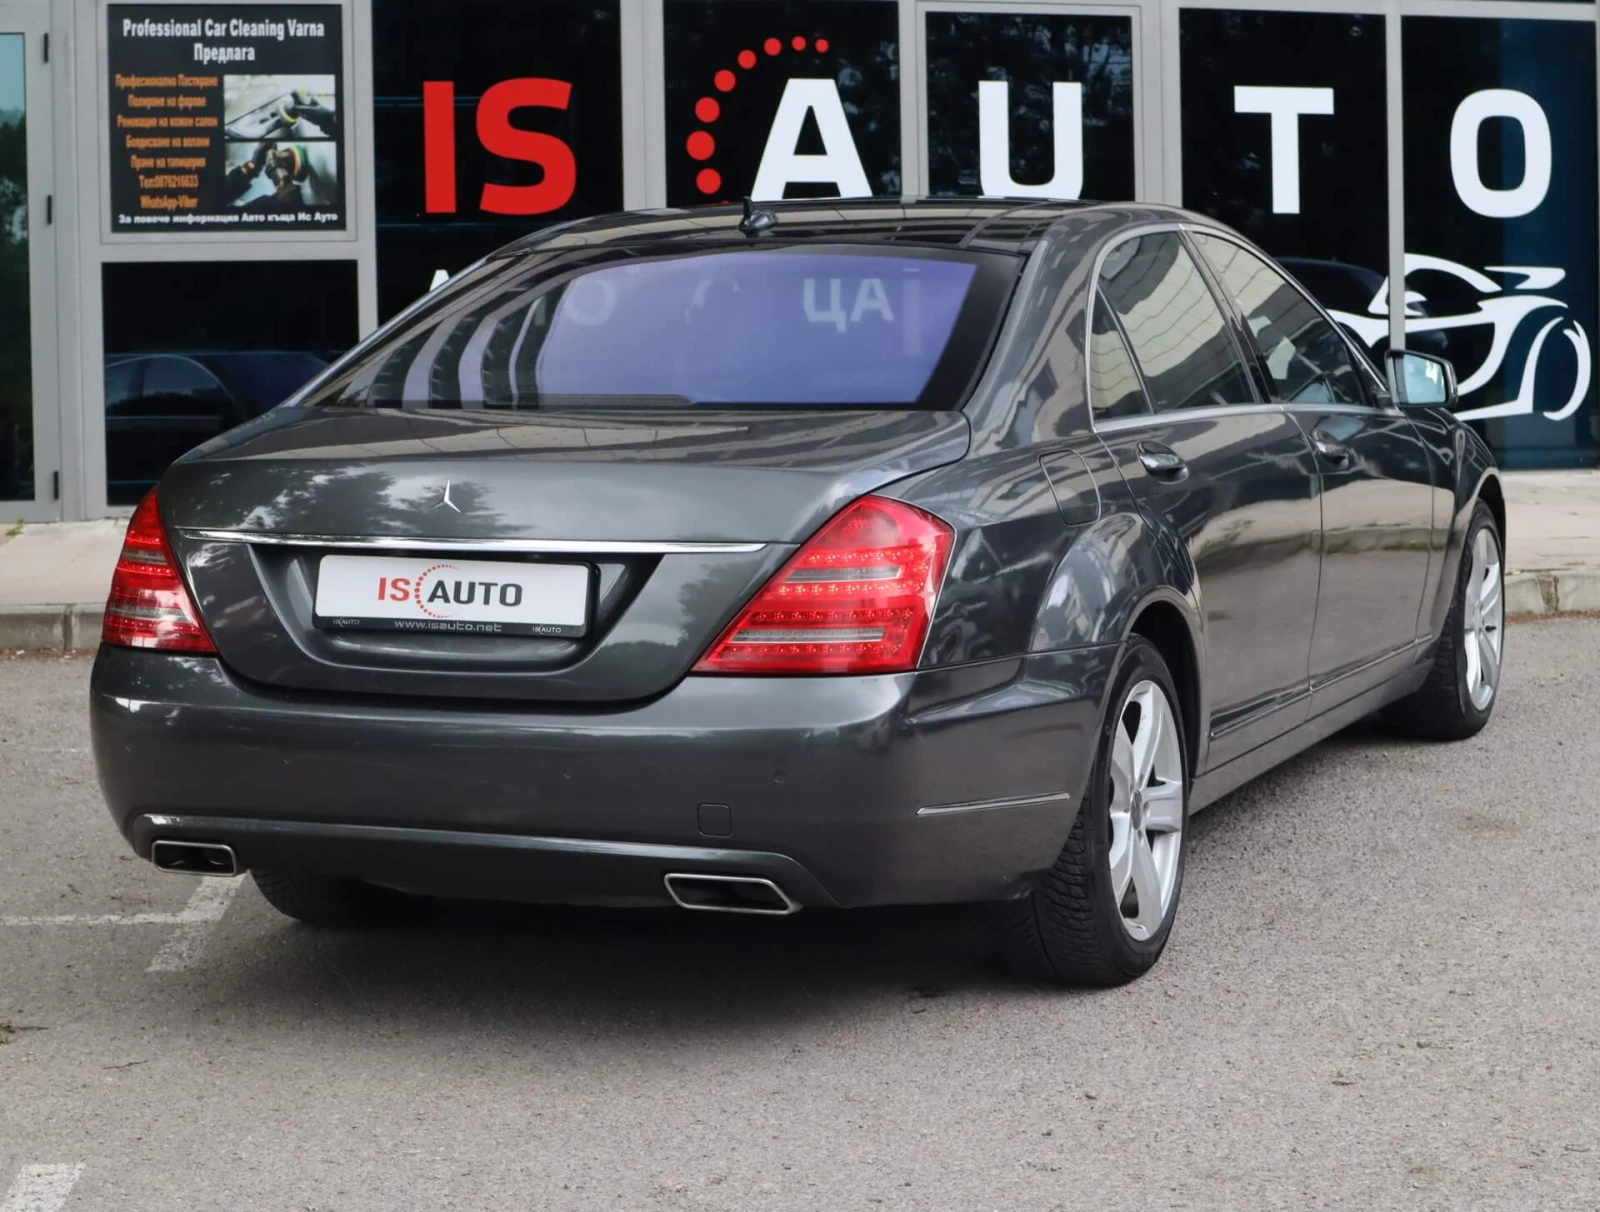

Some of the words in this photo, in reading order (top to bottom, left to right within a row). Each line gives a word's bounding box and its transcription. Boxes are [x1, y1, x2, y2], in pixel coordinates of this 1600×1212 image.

[123, 18, 201, 37] Professional
[204, 18, 227, 37] Car
[229, 18, 285, 41] Cleaning
[287, 18, 325, 37] Varna
[193, 42, 256, 65] Предлага
[423, 78, 576, 215] IS
[118, 214, 133, 224] За
[134, 215, 170, 224] повече
[172, 213, 239, 225] информация
[241, 213, 265, 223] Авто
[267, 213, 296, 224] къща
[298, 212, 312, 222] Ис
[314, 212, 338, 223] Ауто
[377, 577, 411, 602] IS
[427, 579, 522, 607] AUTO
[394, 620, 503, 632] www.isauto.net
